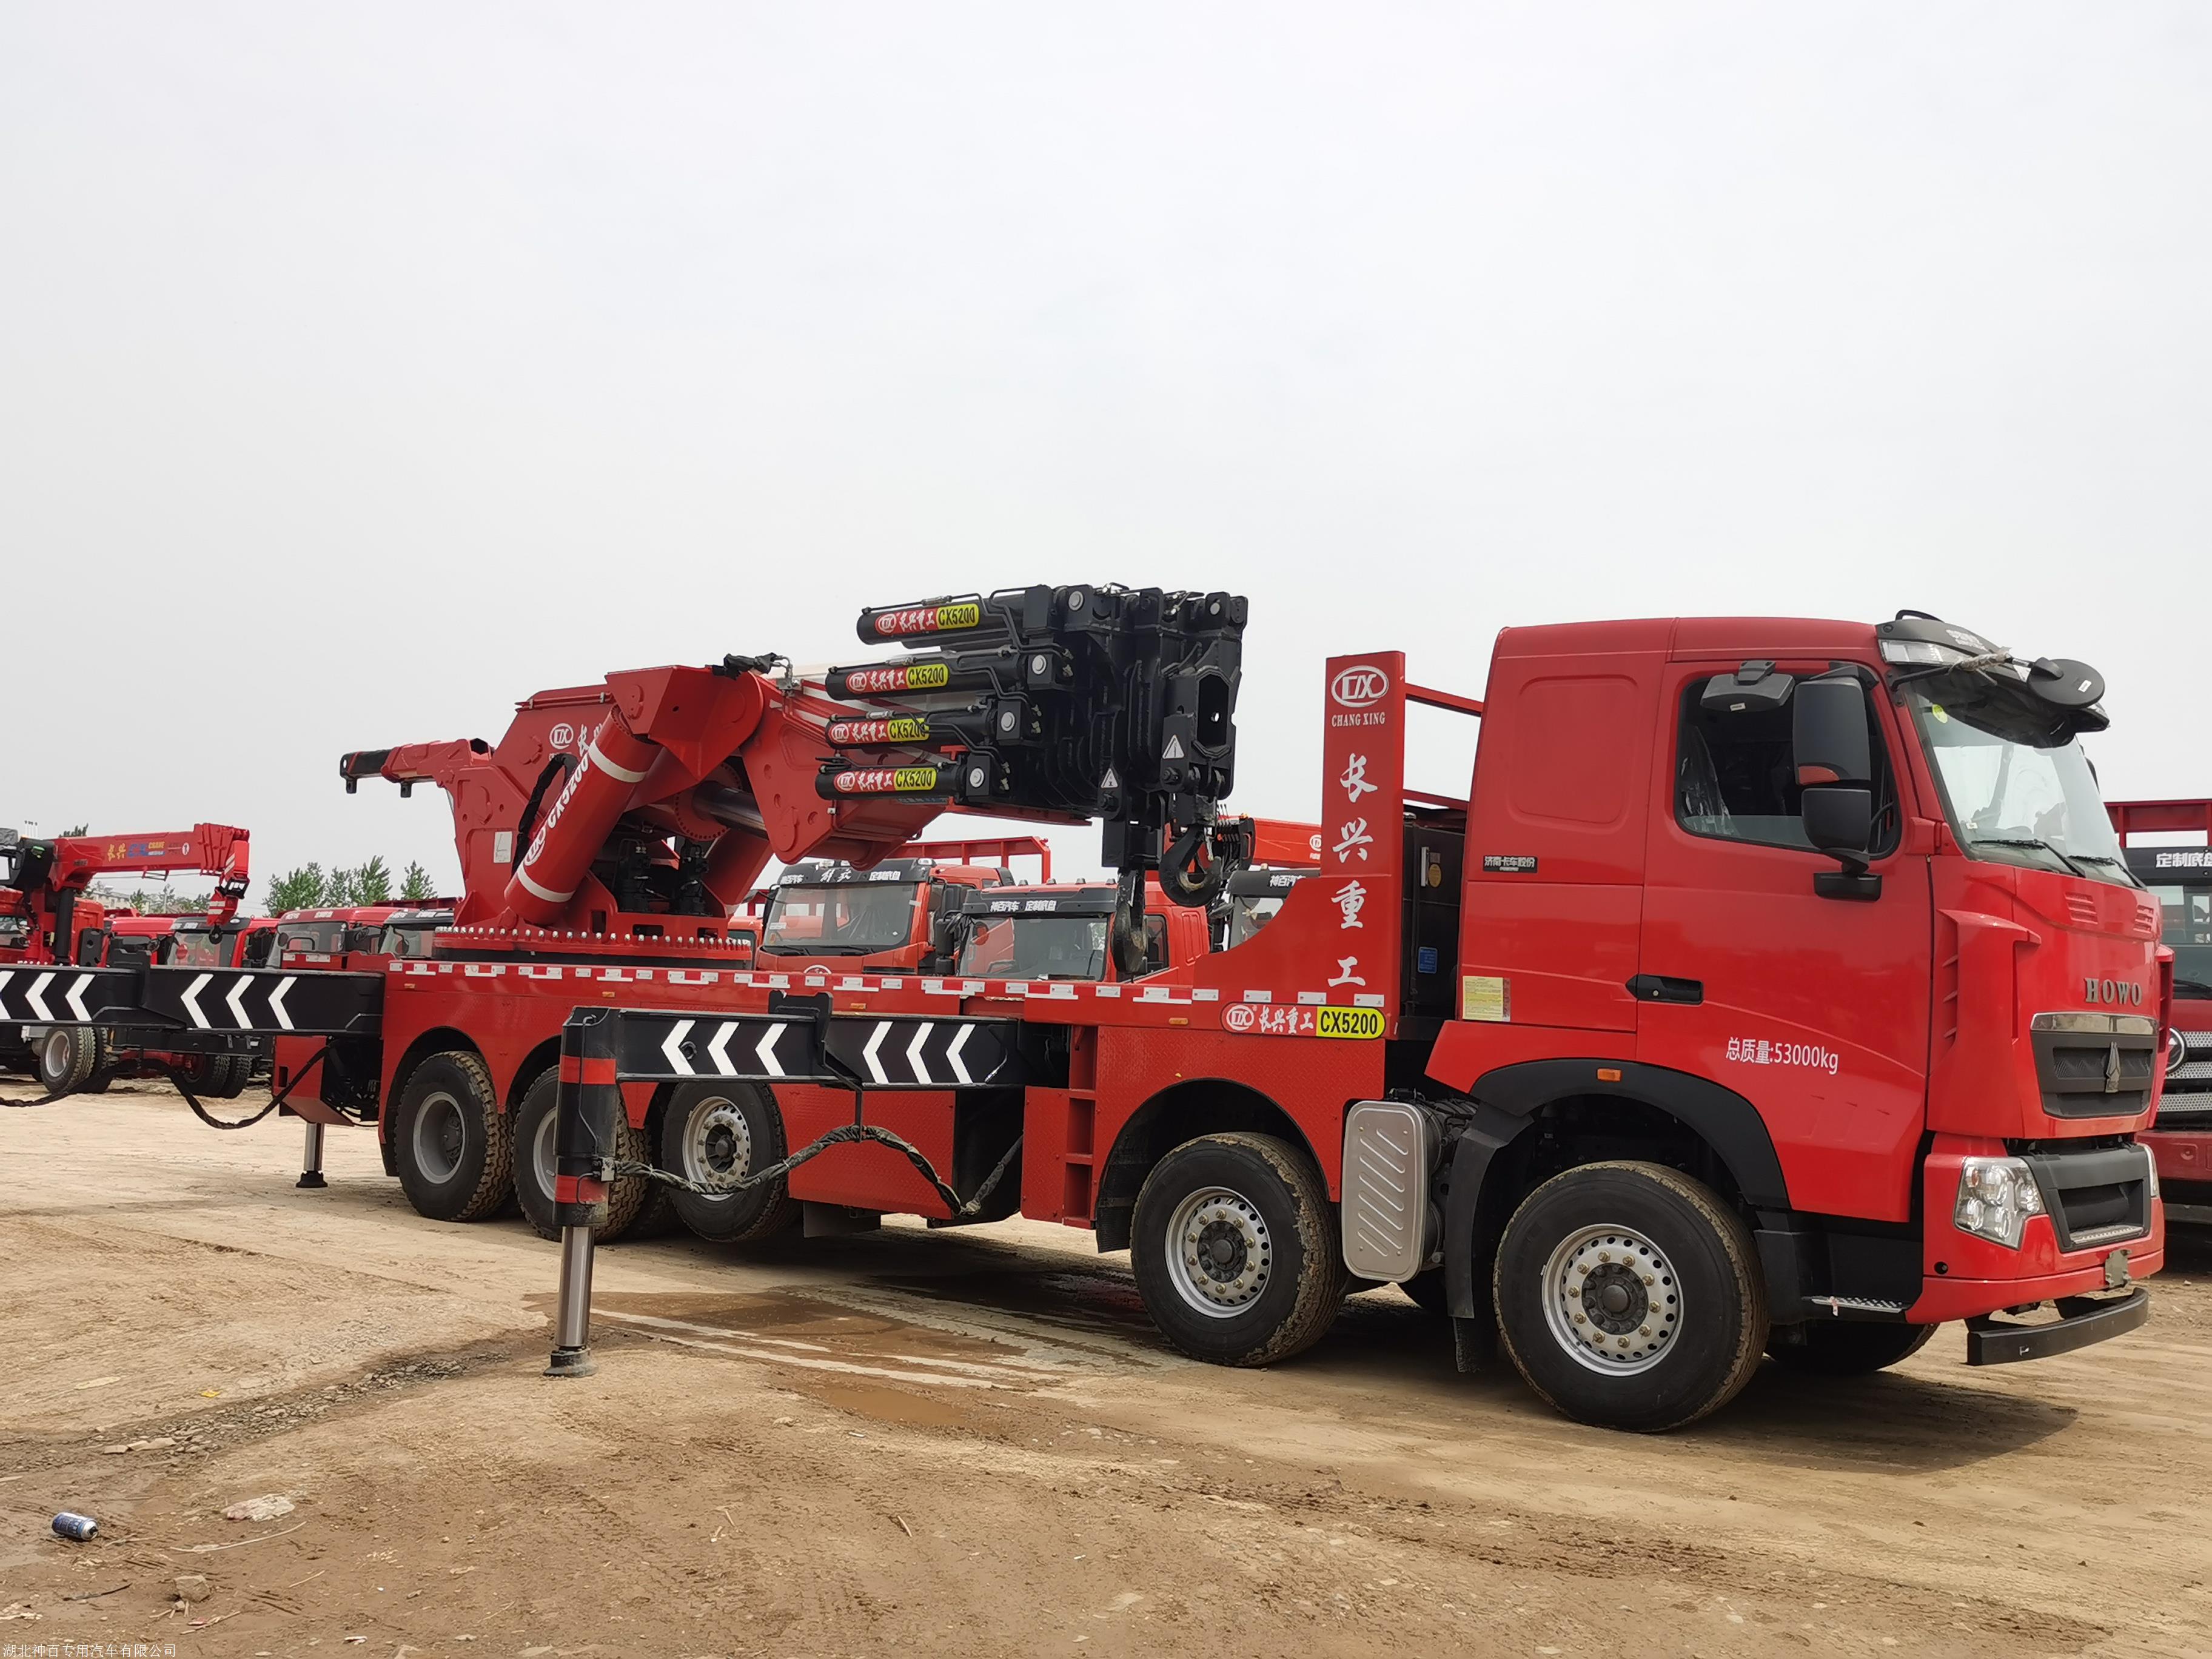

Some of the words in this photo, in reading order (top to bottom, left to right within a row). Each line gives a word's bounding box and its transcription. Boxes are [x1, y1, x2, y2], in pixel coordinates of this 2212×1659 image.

[899, 609, 936, 632] 长兴重工
[938, 607, 975, 626] CX5200
[869, 669, 905, 691] 长兴重工
[908, 667, 943, 685] CX5200
[1332, 714, 1361, 727] CHANG
[1363, 712, 1385, 725] XING
[851, 722, 886, 742] 长兴重工
[546, 755, 589, 829] CX5200
[857, 771, 893, 790] 长兴重工
[896, 770, 933, 787] CX5200
[1327, 752, 1378, 987] 长兴重工
[1484, 856, 1535, 868] 济南卡车股份
[1270, 875, 1306, 886] 神百汽
[2085, 978, 2142, 1007] HOWO
[1259, 1005, 1313, 1034] 长兴重工
[1320, 1011, 1378, 1034] CX5200
[1726, 1037, 1839, 1074] 总质量:53000kg
